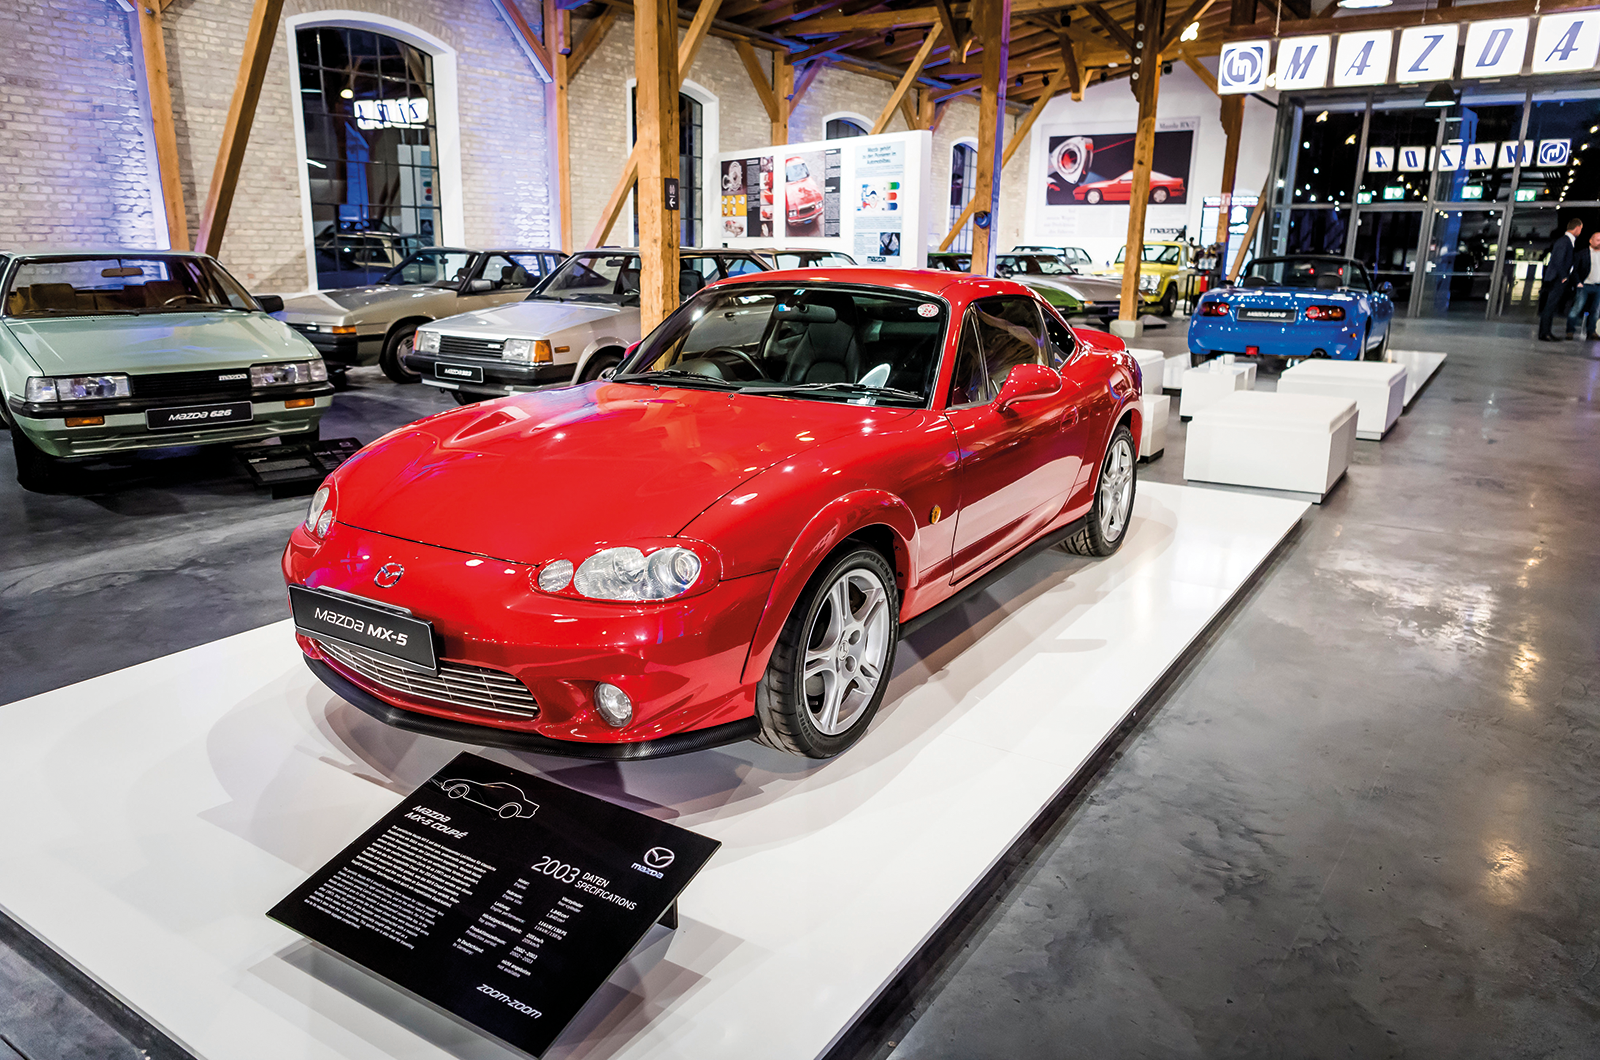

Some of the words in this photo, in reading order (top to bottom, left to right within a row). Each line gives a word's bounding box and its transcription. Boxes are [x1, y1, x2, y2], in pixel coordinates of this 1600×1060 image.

[1284, 21, 1584, 80] MAZDA
[168, 411, 209, 421] Mazda
[210, 409, 232, 418] 626
[314, 607, 365, 633] Mazda
[367, 623, 408, 647] MX-5
[404, 812, 434, 826] MX-5
[430, 822, 469, 840] COUPÉ
[411, 805, 452, 823] Mazda
[530, 855, 581, 884] 2003
[582, 872, 610, 888] DATEN
[630, 862, 665, 880] mazda
[574, 880, 638, 911] SPECIFICATIONS
[476, 983, 542, 1019] zoom-zoom
